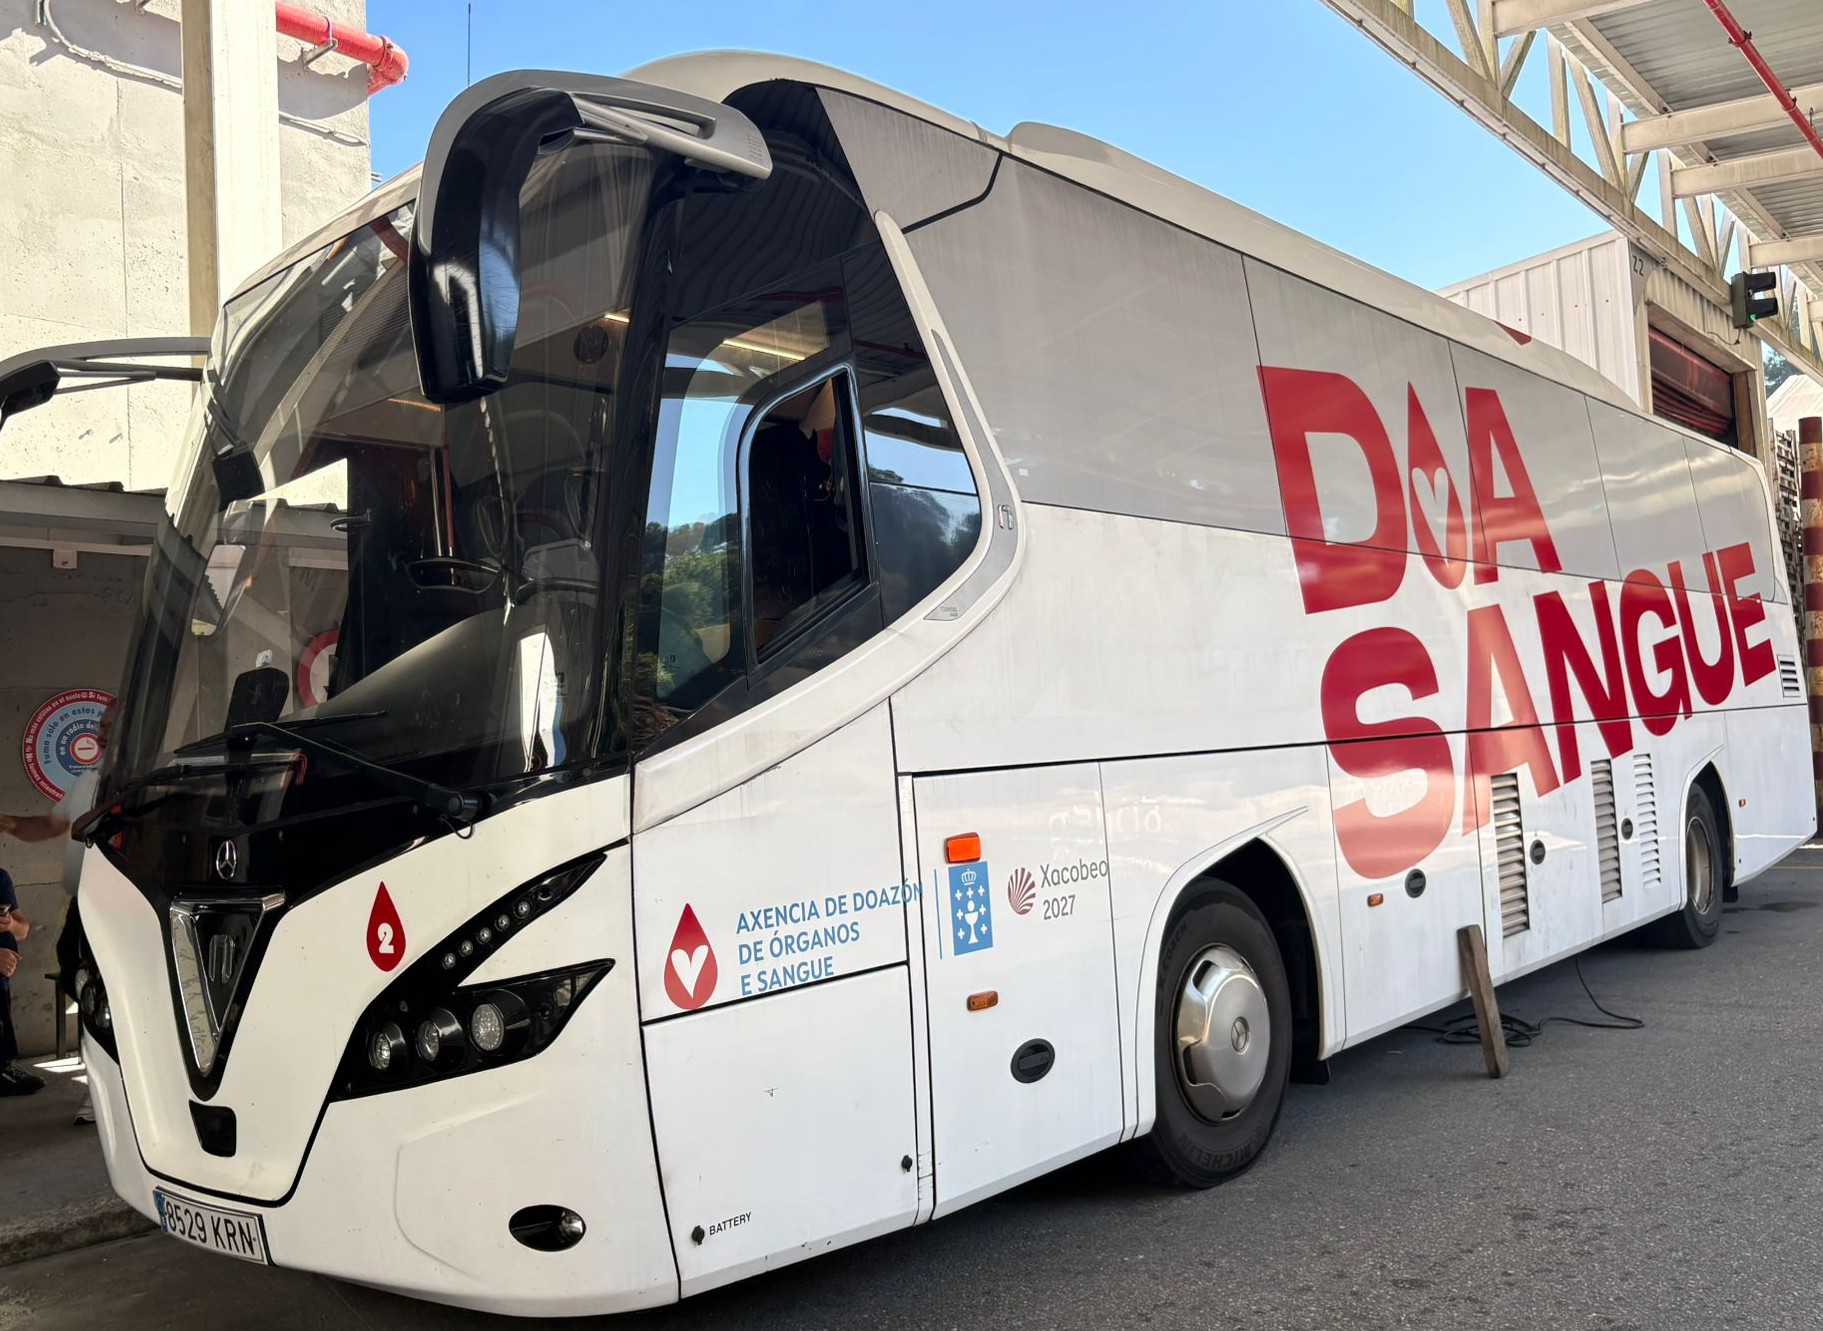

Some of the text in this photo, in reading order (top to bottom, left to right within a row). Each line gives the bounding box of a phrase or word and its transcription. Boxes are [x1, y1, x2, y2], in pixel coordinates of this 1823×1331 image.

[1632, 255, 1644, 276] 22
[72, 707, 95, 715] estos
[1320, 541, 1776, 880] SANGUE
[1040, 858, 1108, 888] Xacobeo
[736, 878, 924, 935] AXENCIA DE DOAZÓN
[1043, 894, 1075, 920] 2027
[377, 922, 395, 954] 2
[738, 921, 860, 965] DE ÓRGANOS
[741, 956, 834, 996] E SANGUE
[165, 1200, 255, 1256] 8529 KRN
[709, 1211, 752, 1236] BATTERY
